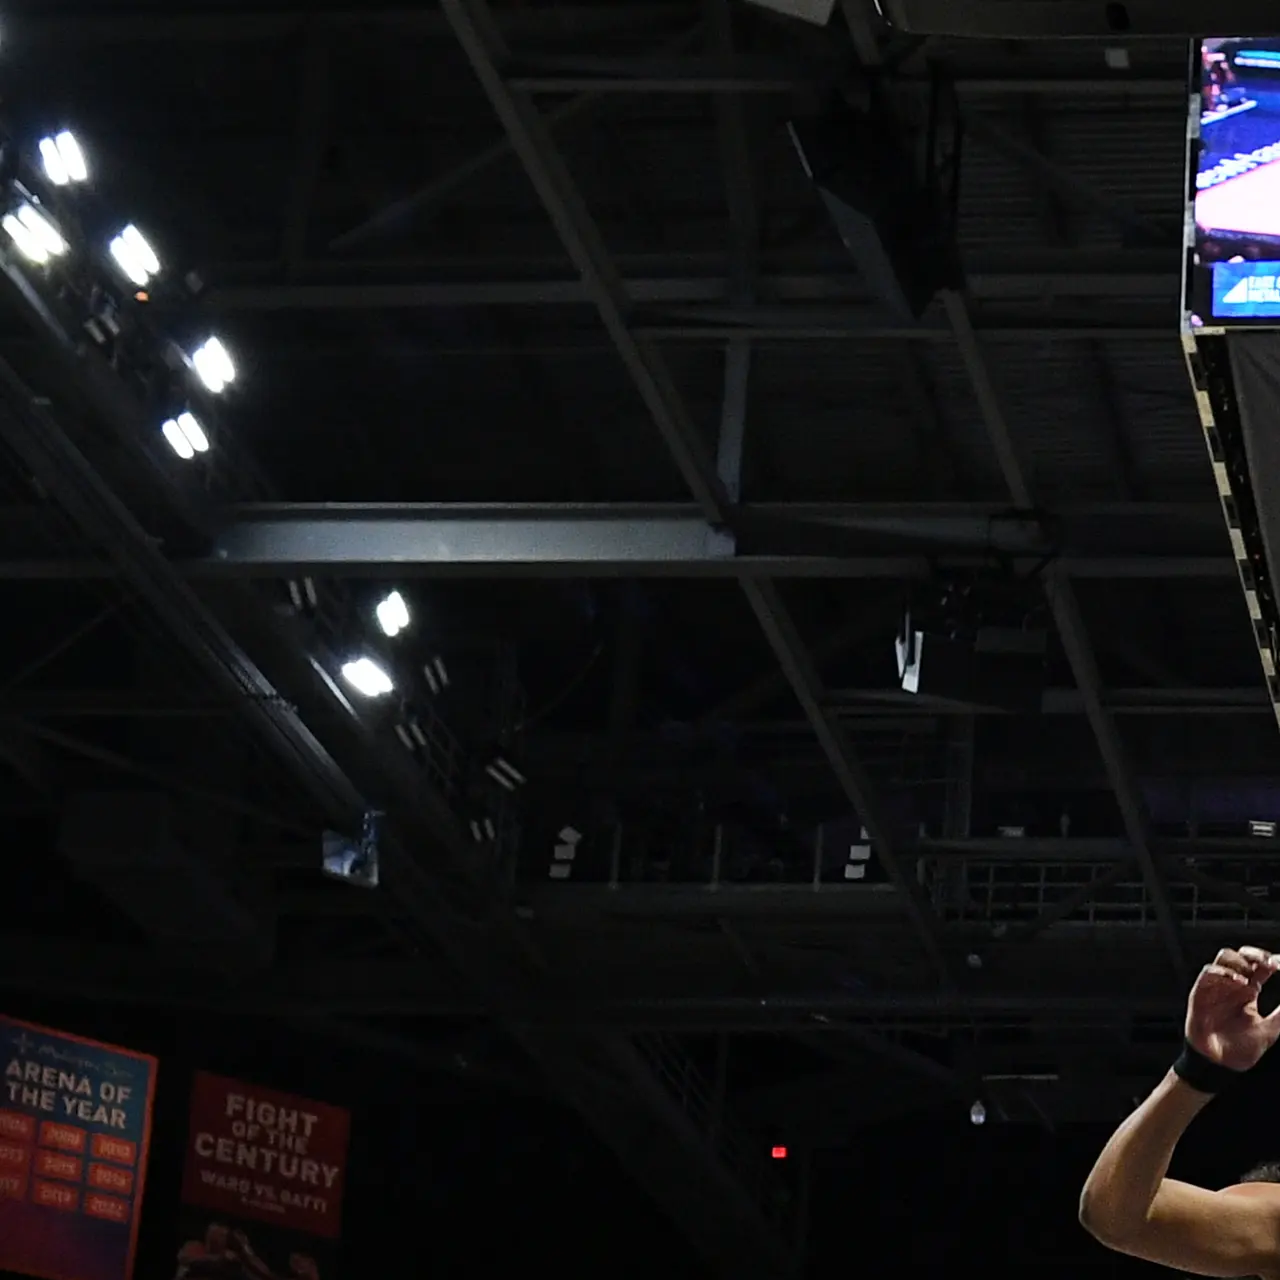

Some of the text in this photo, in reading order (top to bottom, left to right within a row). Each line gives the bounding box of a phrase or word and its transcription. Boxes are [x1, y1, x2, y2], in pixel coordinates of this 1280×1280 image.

[5, 1059, 132, 1105] ARENA OF
[5, 1081, 126, 1130] THE YEAR
[226, 1093, 319, 1138] FIGHT
[194, 1132, 340, 1189] CENTURY
[232, 1119, 310, 1156] OF THE
